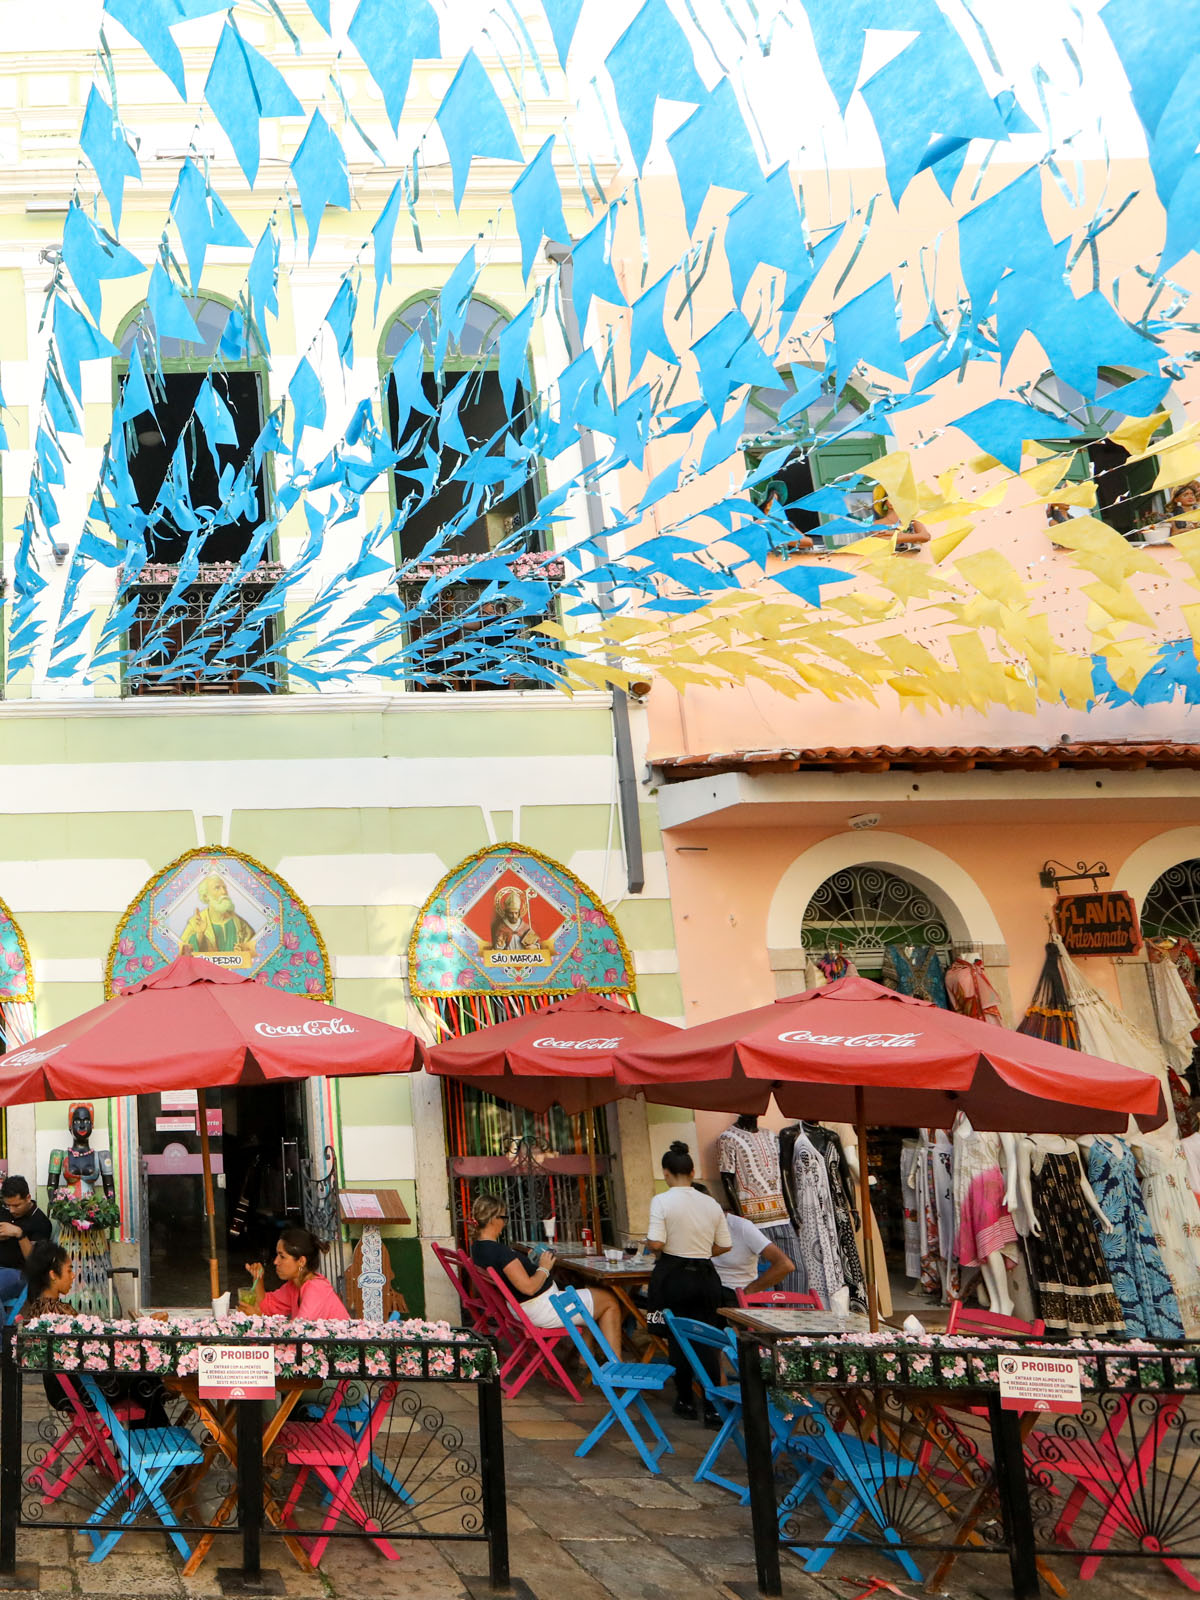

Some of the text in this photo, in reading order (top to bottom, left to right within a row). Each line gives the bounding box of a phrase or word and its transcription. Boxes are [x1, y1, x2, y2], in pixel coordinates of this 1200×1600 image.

[1065, 926, 1128, 948] Artesanato
[212, 956, 242, 965] PEDRO
[491, 953, 508, 963] SÃO
[254, 1017, 356, 1038] Coca-Cola
[532, 1037, 624, 1050] Coca-Cola
[777, 1030, 924, 1047] Coca-Cola
[220, 1350, 270, 1360] PROIBIDO
[1021, 1361, 1073, 1373] PROIBIDO
